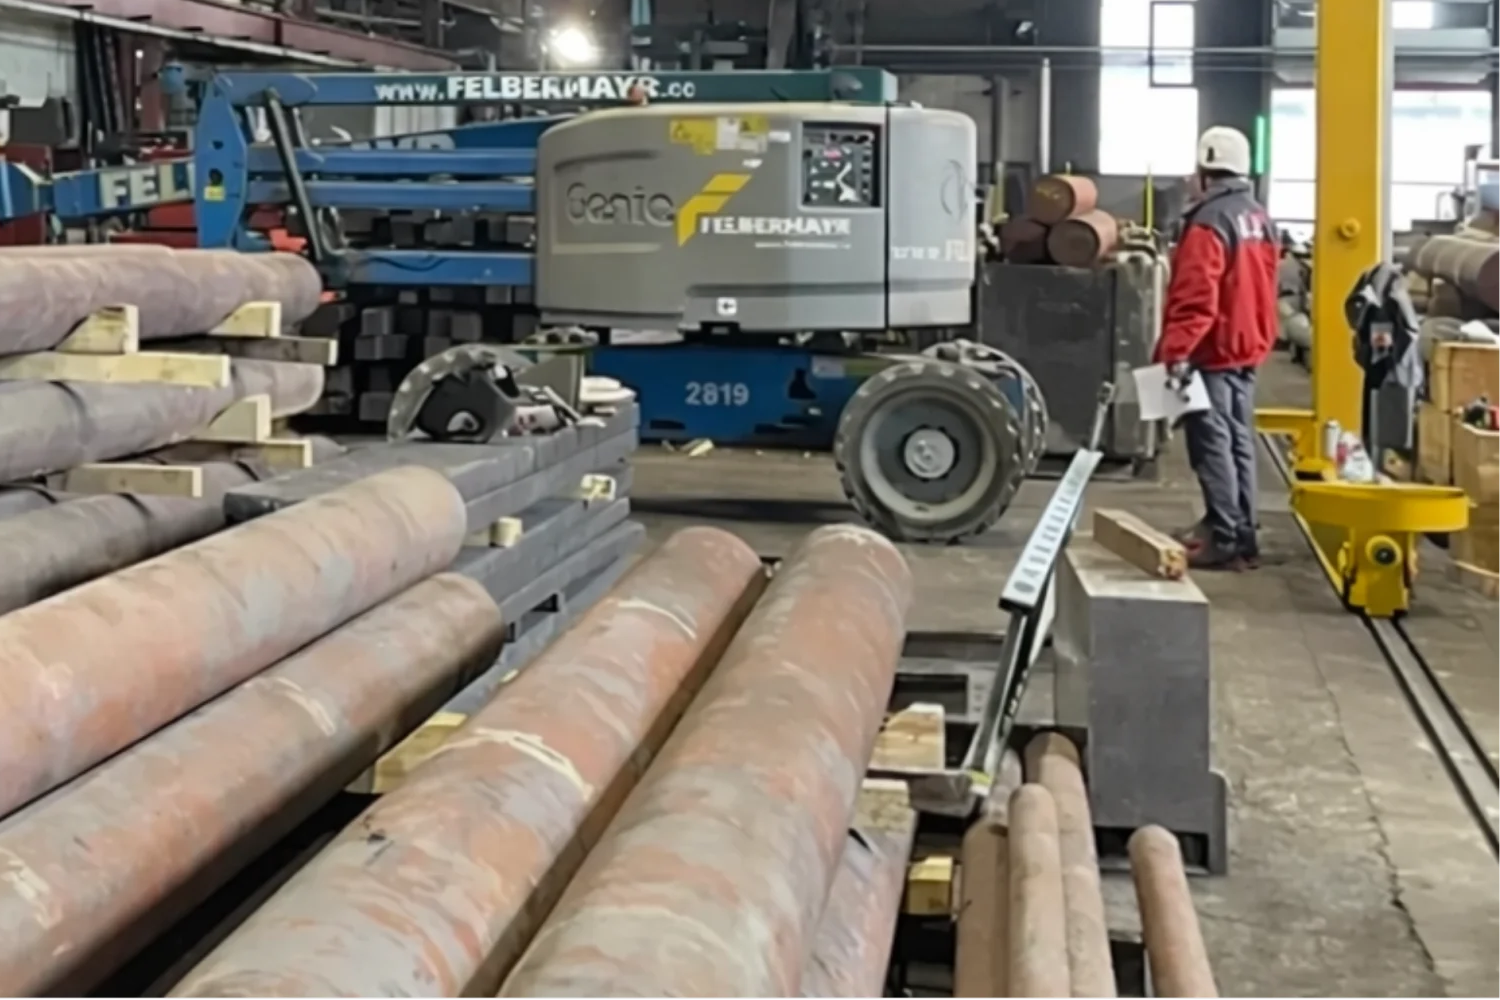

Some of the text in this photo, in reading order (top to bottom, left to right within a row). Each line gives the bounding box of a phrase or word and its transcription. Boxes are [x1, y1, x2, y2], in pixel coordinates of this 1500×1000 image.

[100, 161, 197, 209] FEL
[566, 181, 676, 227] Genie
[684, 381, 750, 407] 2819
